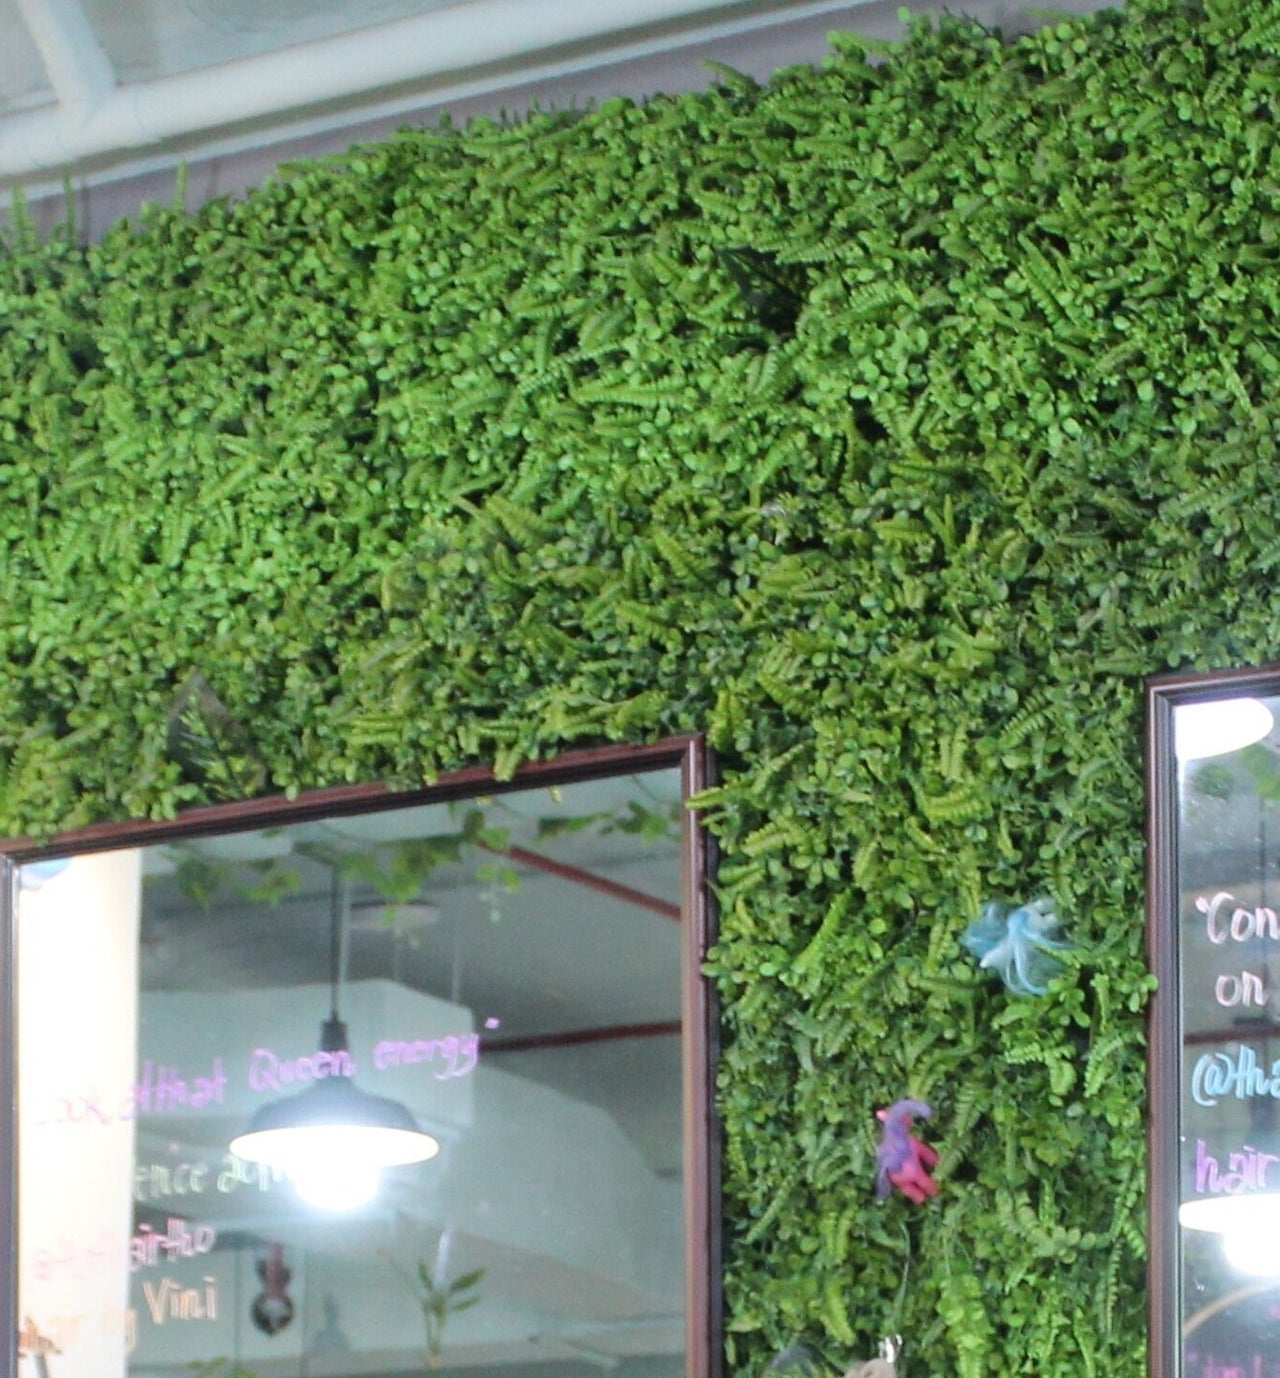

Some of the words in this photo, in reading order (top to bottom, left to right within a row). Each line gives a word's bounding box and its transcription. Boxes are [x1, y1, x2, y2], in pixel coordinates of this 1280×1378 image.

[1216, 970, 1270, 1007] on
[1196, 1139, 1280, 1194] hair
[142, 1276, 219, 1325] Vini
